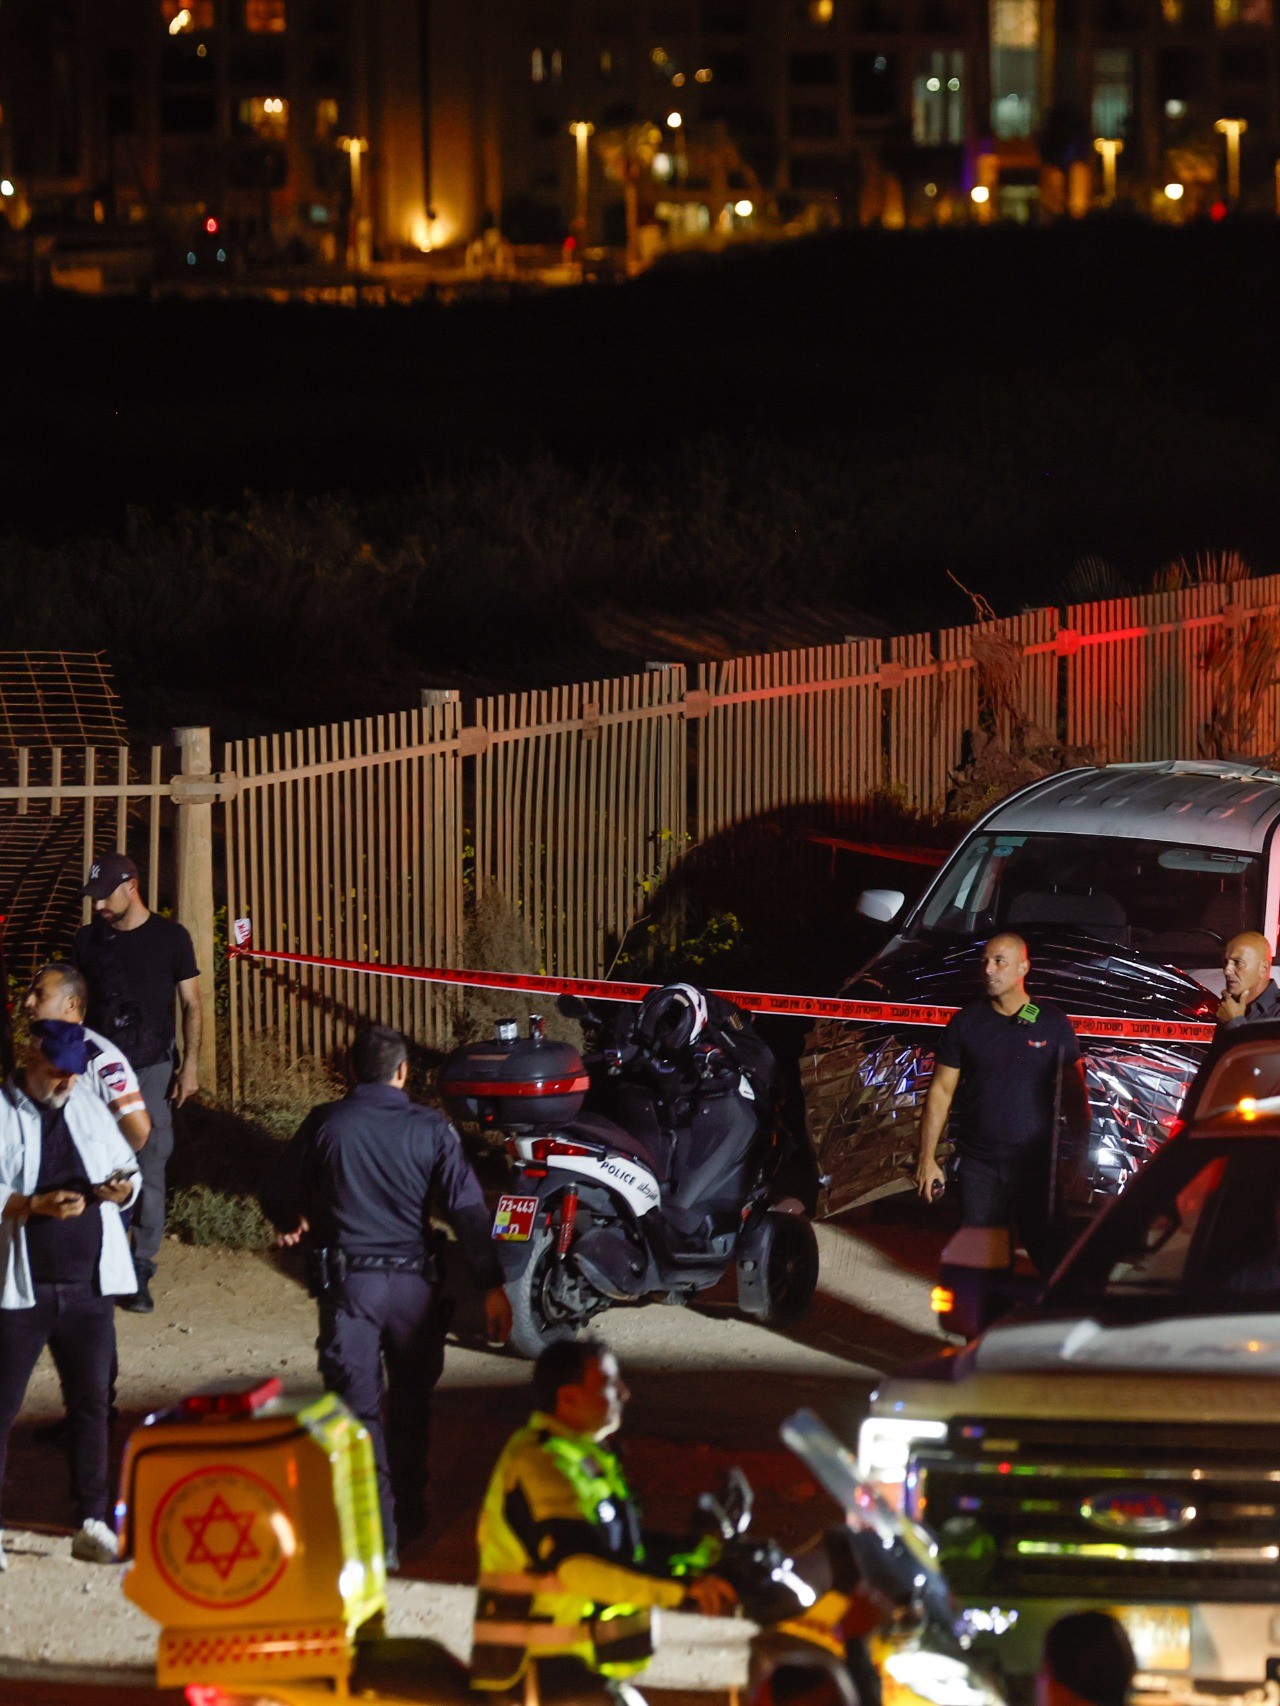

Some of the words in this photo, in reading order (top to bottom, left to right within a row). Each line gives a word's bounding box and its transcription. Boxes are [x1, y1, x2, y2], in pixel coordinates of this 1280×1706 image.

[1095, 1020, 1123, 1032] משטרת
[601, 1161, 636, 1185] POLICE
[500, 1200, 535, 1213] 73-443
